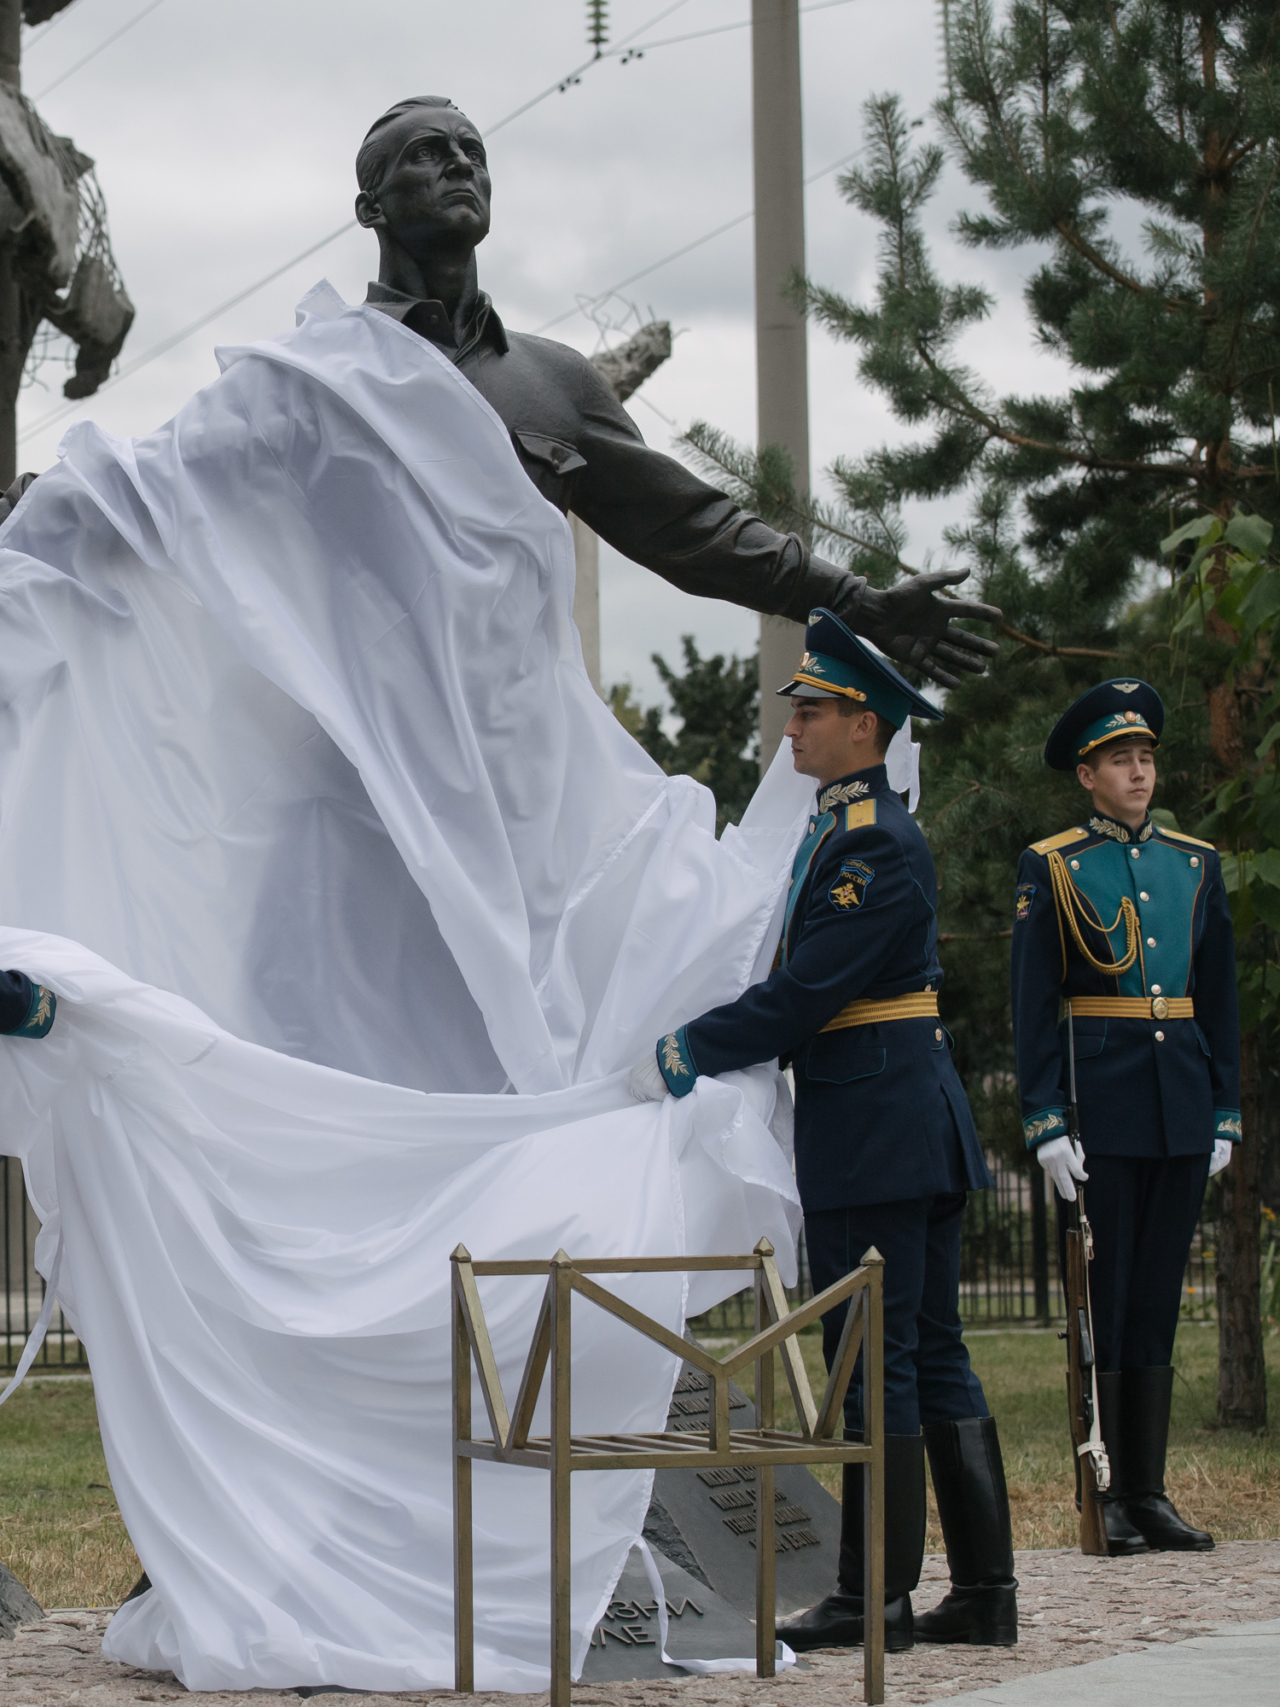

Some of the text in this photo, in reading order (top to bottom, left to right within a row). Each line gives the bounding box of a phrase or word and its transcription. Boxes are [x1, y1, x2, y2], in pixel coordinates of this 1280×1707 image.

[841, 870, 868, 887] РОССИЯ
[605, 1596, 704, 1621] ЗНИ
[590, 1624, 656, 1647] ЛЕ
